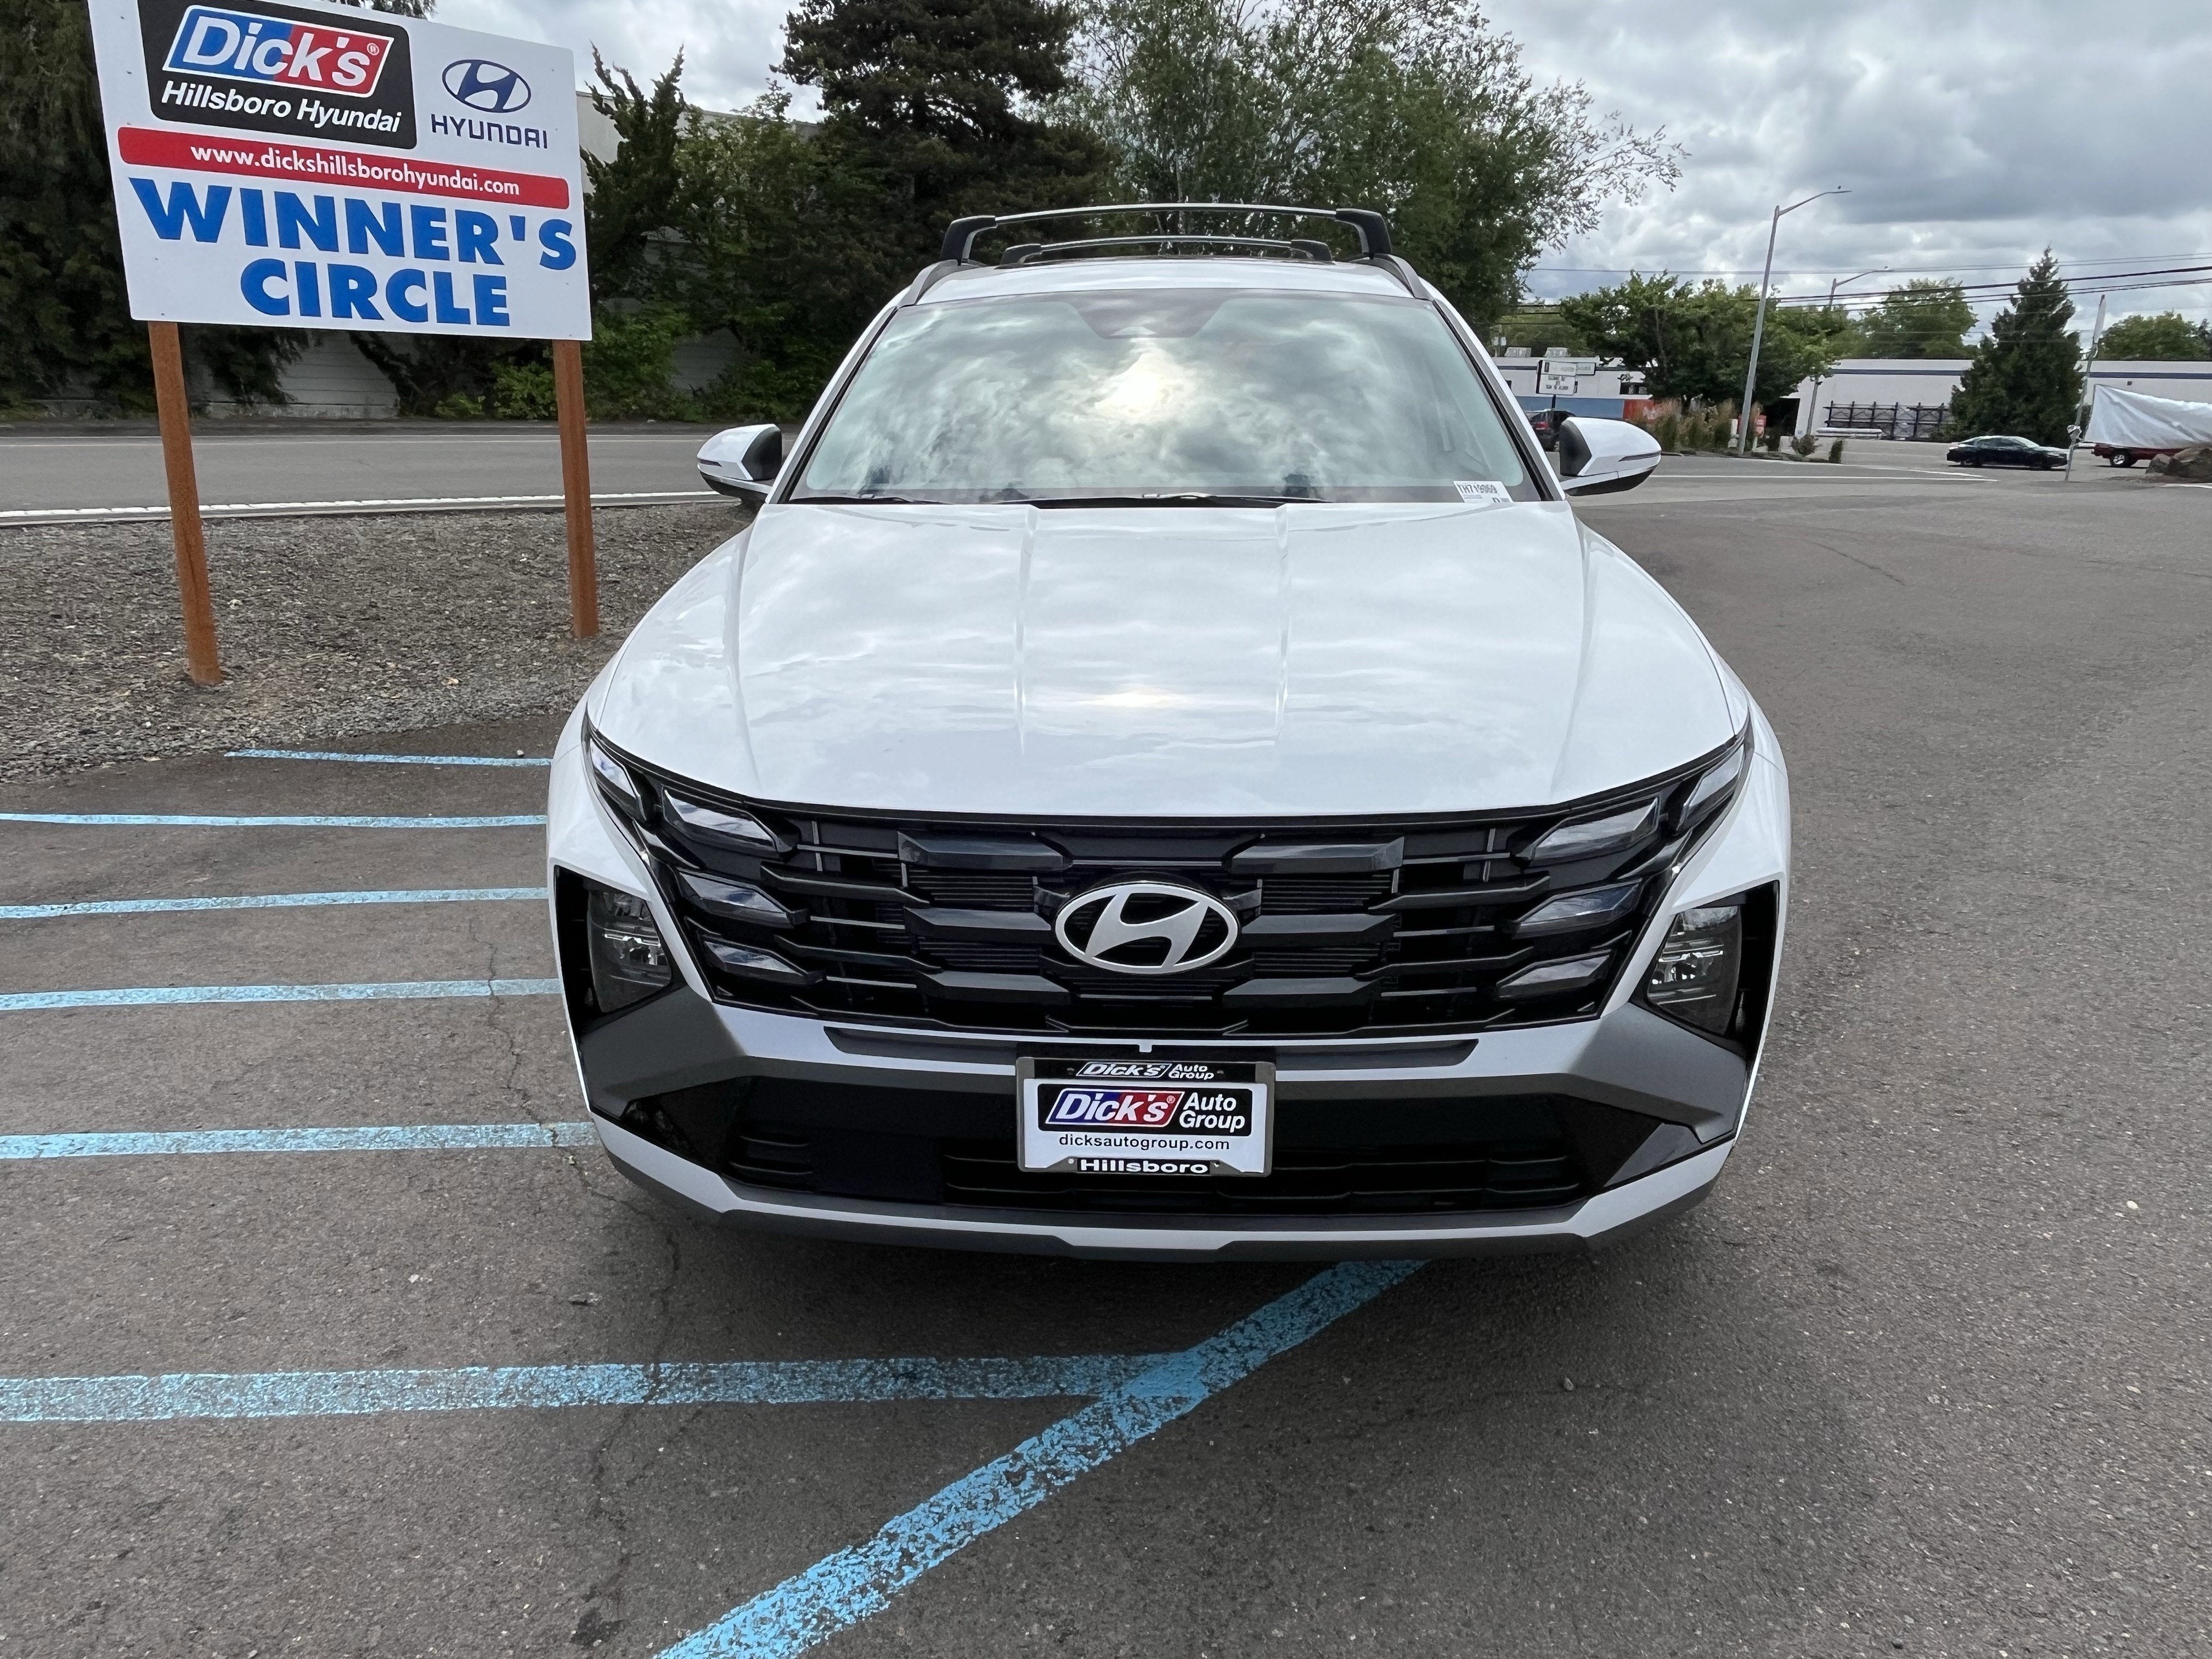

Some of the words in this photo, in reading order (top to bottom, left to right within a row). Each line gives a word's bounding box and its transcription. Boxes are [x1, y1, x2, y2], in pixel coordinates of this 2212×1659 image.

[184, 16, 371, 87] Dick's
[162, 81, 291, 118] Hillsboro
[297, 100, 401, 133] Hyundai
[431, 114, 548, 149] HYUNDAI
[190, 145, 520, 196] www.dickshillsborohyundai.com
[129, 177, 577, 270] WINNER'S
[240, 258, 510, 326] CIRCLE
[1084, 1063, 1159, 1077] Dick's
[1169, 1070, 1215, 1080] Group
[1175, 1063, 1208, 1072] Auto
[1056, 1093, 1169, 1122] Dick's
[1183, 1092, 1237, 1111] Auto
[1179, 1109, 1245, 1133] Group
[1059, 1134, 1230, 1151] dicksautogroup.com
[1081, 1160, 1208, 1173] Hillsboro
